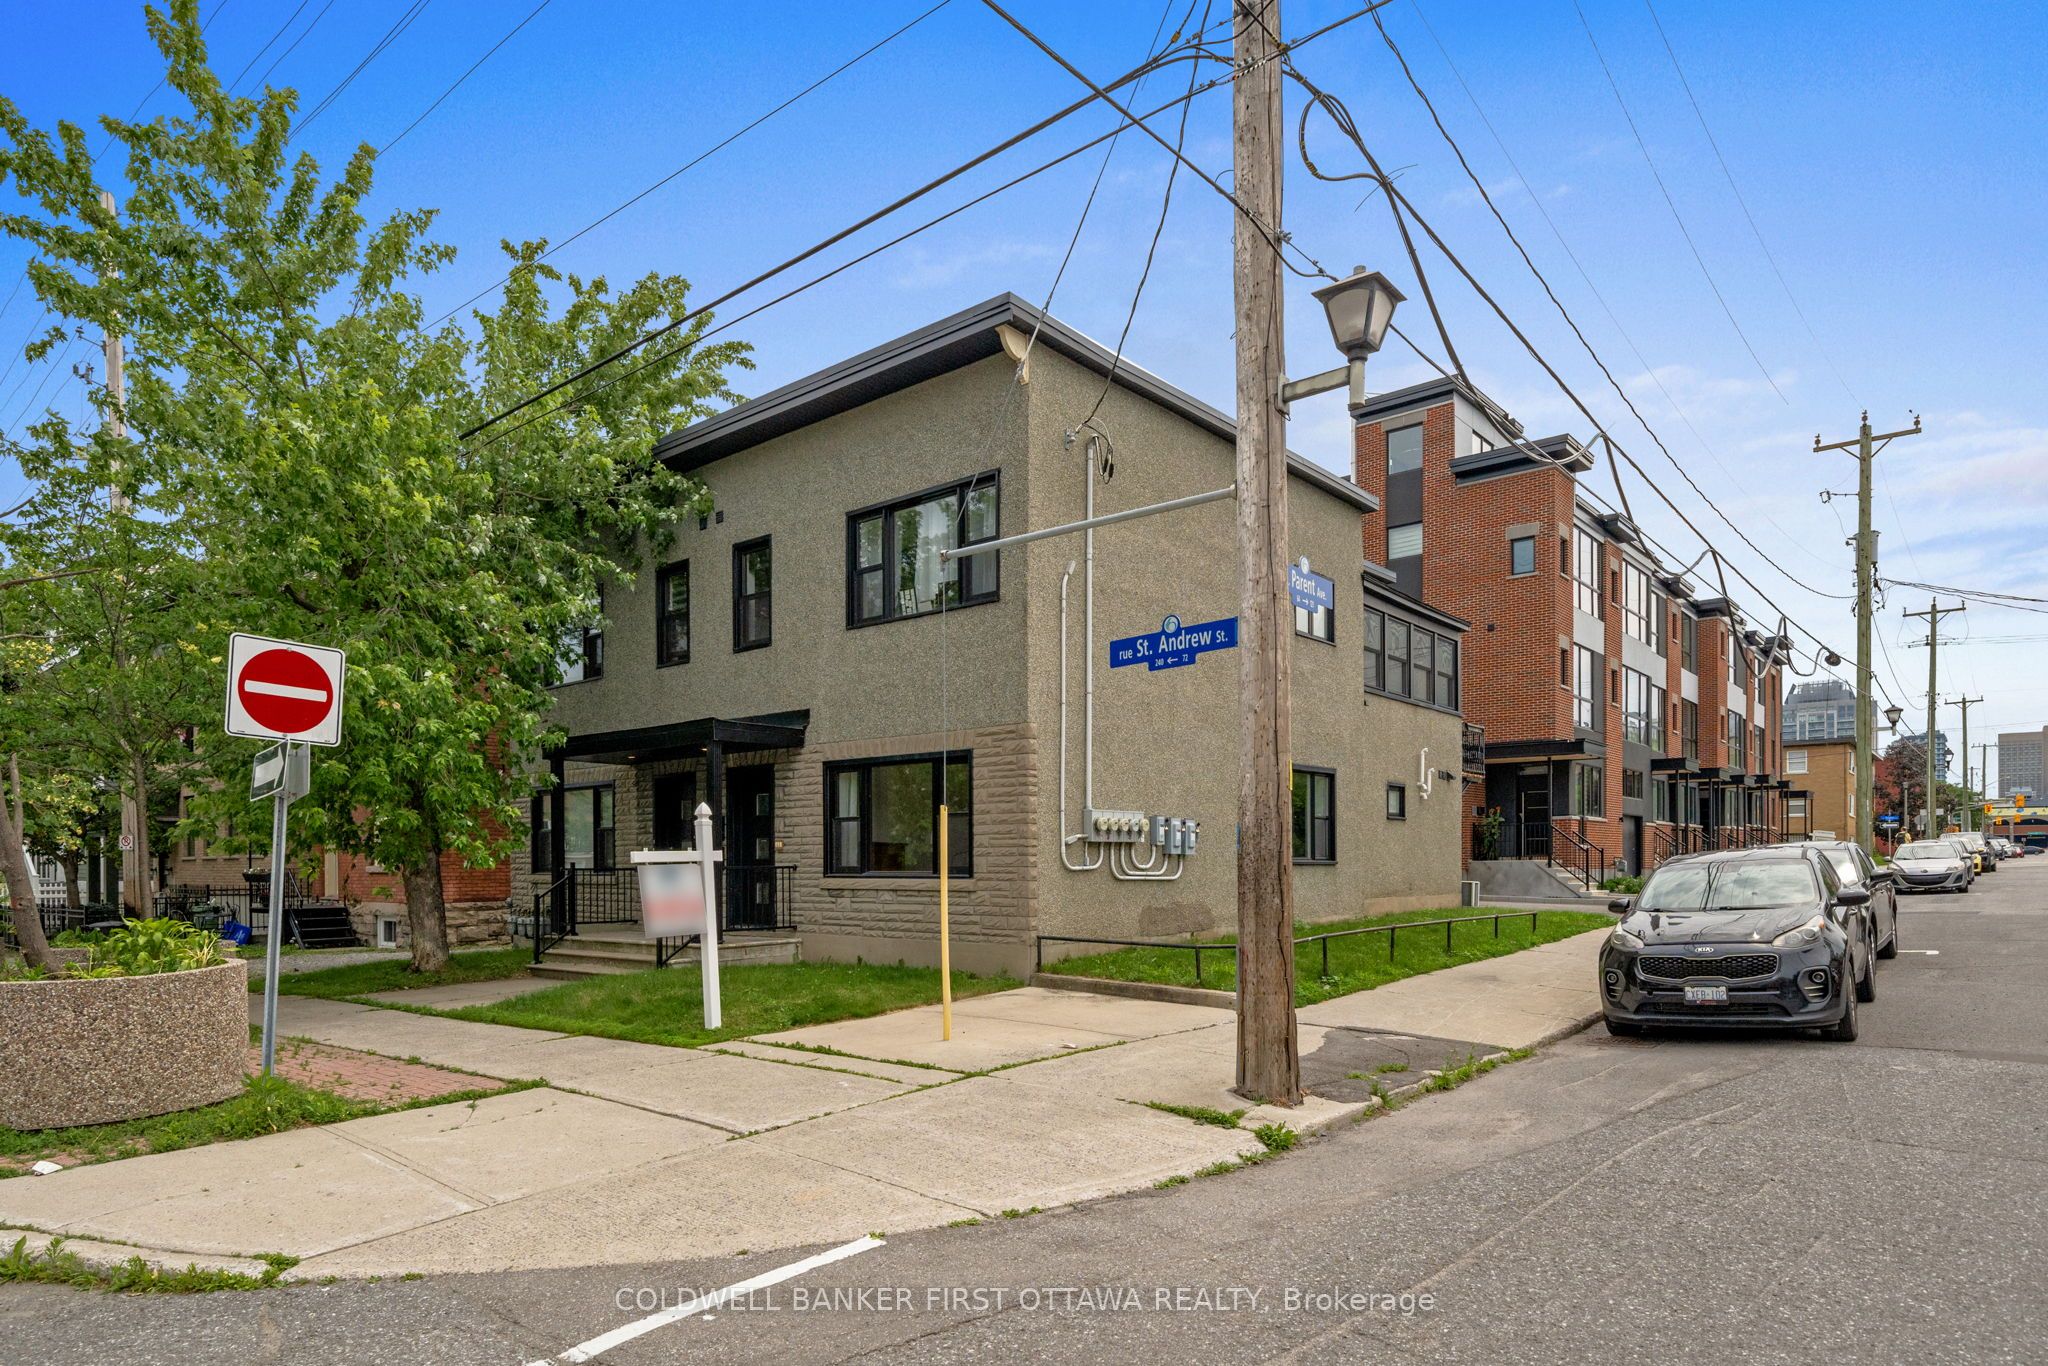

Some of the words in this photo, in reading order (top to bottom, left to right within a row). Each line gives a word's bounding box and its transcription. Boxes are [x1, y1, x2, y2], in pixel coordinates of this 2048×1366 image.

[1291, 569, 1315, 596] Parent
[1119, 649, 1133, 660] rue
[1136, 639, 1153, 657] St.
[1158, 630, 1212, 653] Andrew
[1216, 630, 1228, 643] St.
